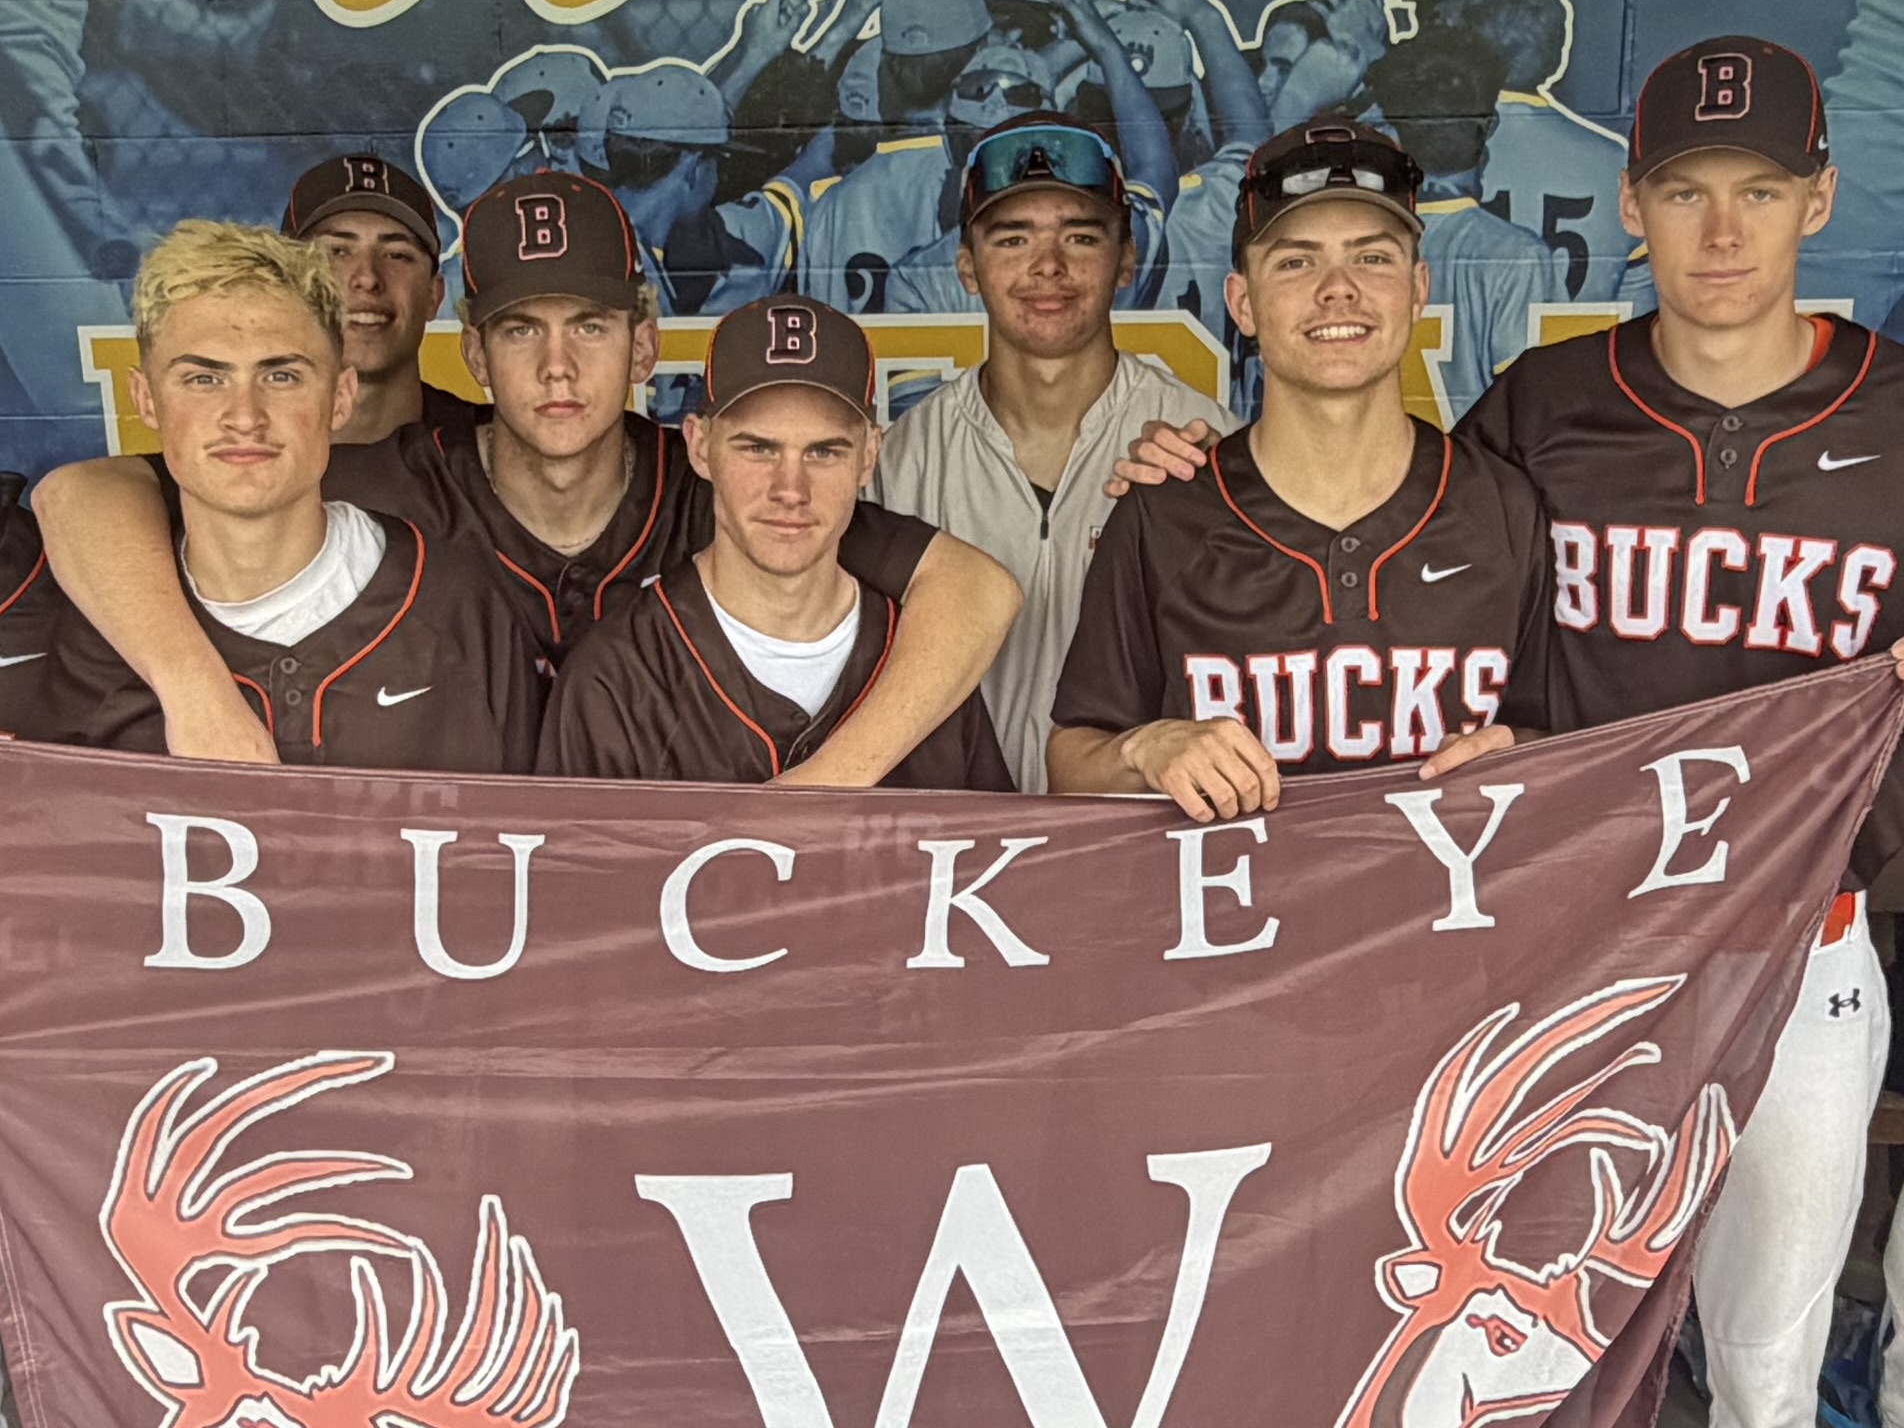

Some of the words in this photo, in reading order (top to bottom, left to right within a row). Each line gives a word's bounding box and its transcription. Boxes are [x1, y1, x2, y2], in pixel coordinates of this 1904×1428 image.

[1694, 52, 1752, 121] B
[343, 155, 390, 195] B
[514, 193, 568, 261] B
[765, 305, 817, 365] B
[1550, 519, 1896, 661] BUCKS
[143, 745, 1751, 981] BUCKEYE
